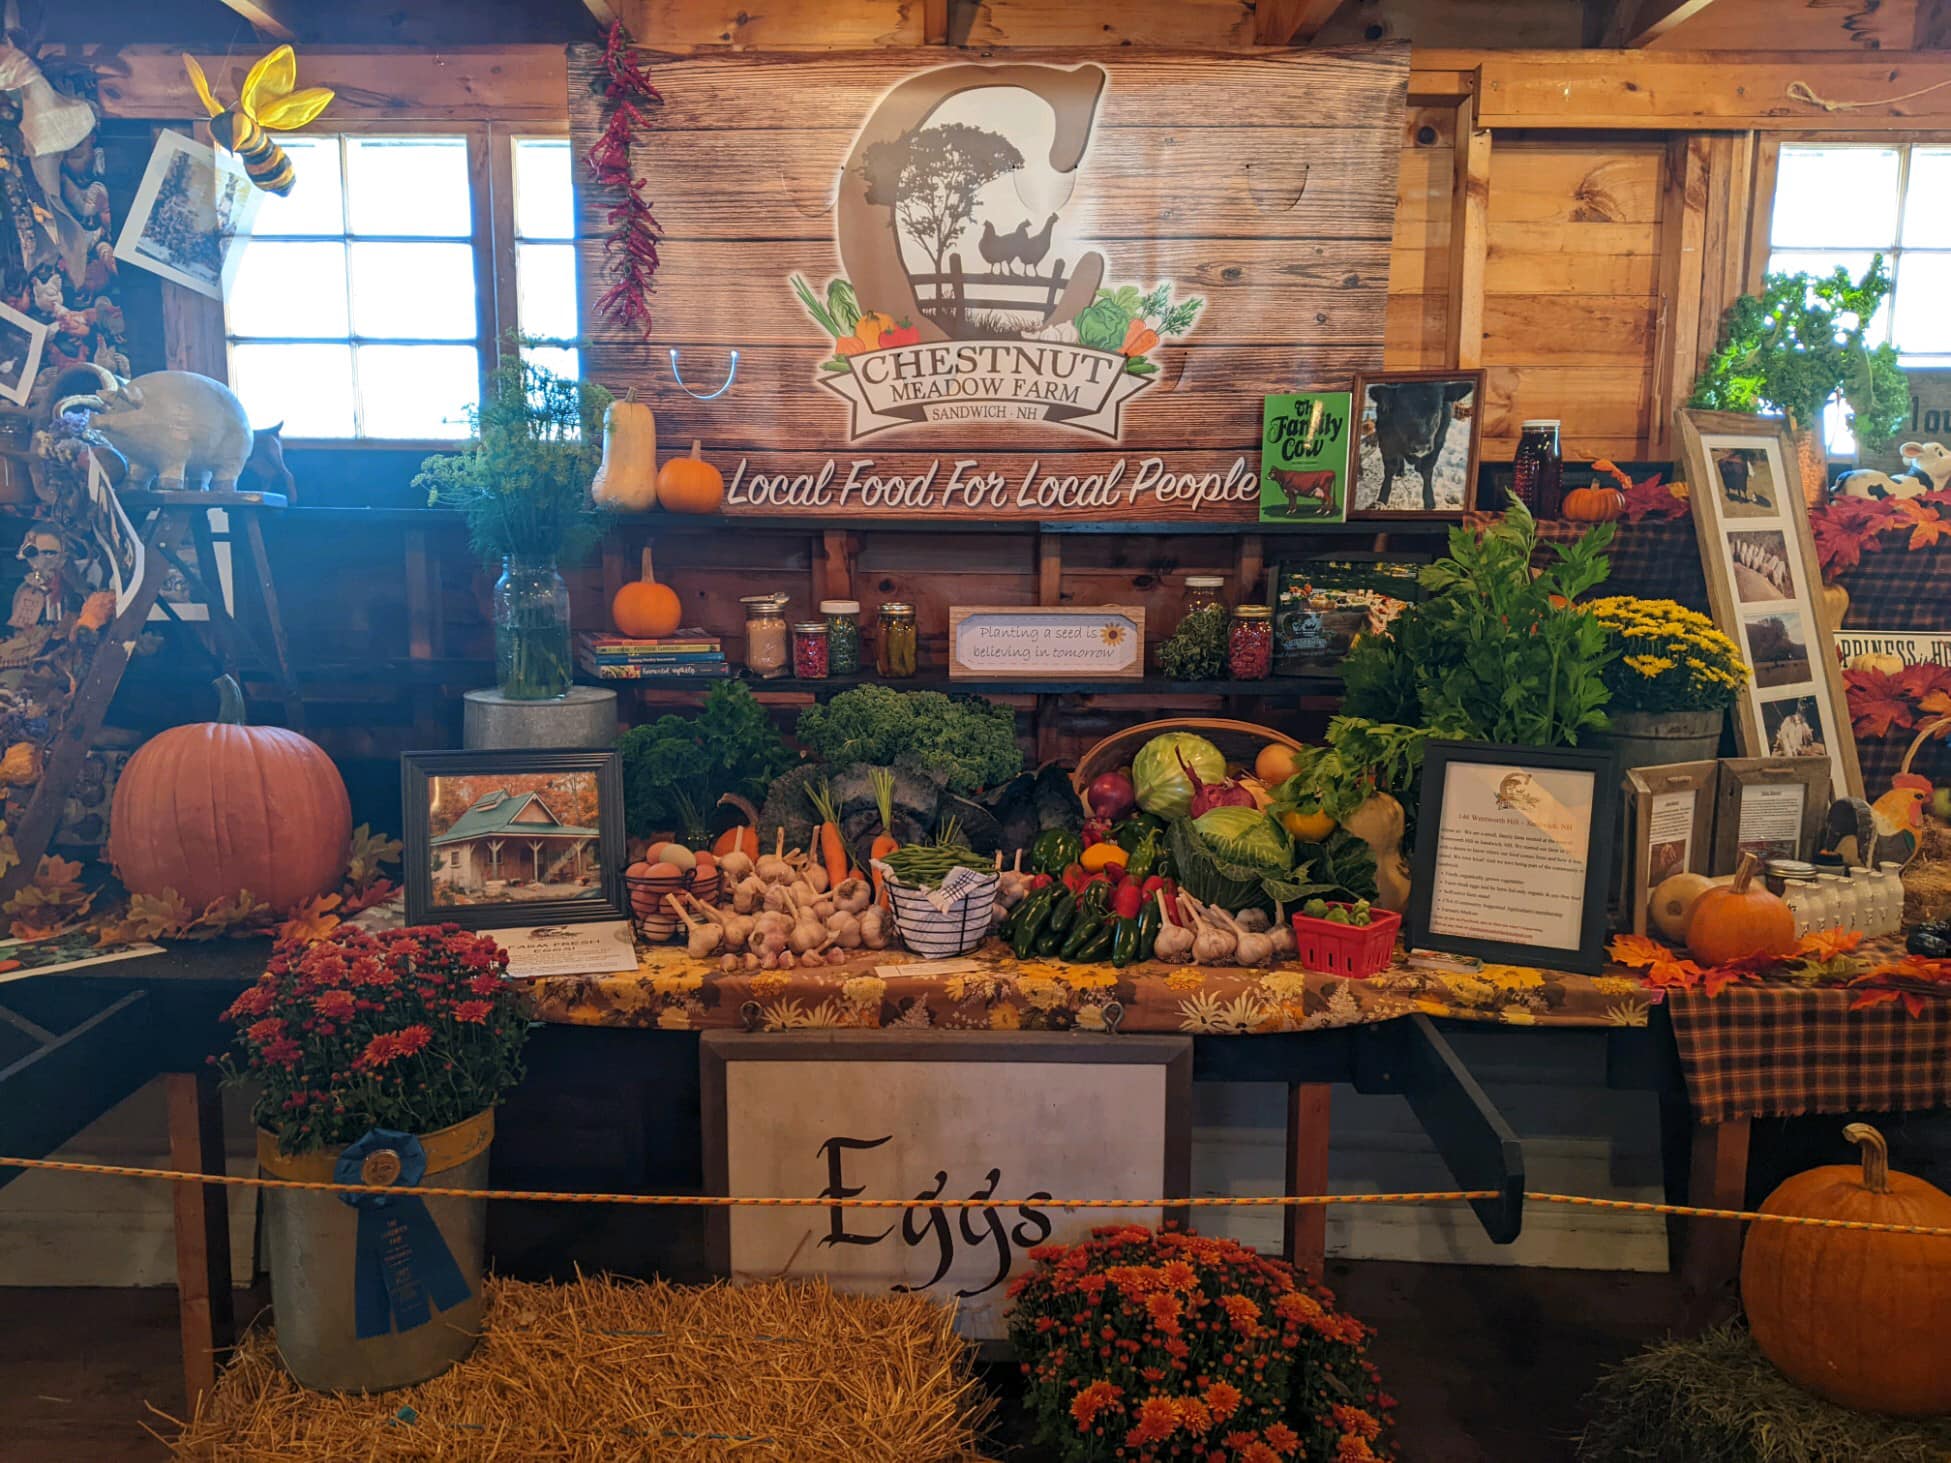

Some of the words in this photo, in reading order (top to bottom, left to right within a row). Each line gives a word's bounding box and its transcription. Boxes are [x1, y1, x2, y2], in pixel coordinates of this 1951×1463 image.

[861, 345, 1114, 385] CHESTNUT
[889, 377, 1003, 402] MEADOW
[1012, 378, 1081, 404] FARM
[932, 405, 1007, 421] SANDWICH
[1016, 407, 1038, 420] NH
[1282, 437, 1324, 461] Cow
[727, 457, 836, 506] Local
[839, 458, 940, 508] Food
[942, 459, 1009, 508] For
[1016, 458, 1126, 508] Local
[1129, 456, 1261, 511] People
[979, 625, 1039, 642] Planting
[1043, 629, 1052, 639] a
[1055, 625, 1082, 639] seed
[1086, 625, 1098, 639] is
[973, 645, 1031, 661] believing
[1034, 646, 1050, 657] in
[1052, 648, 1115, 658] tomorrow
[816, 1134, 1054, 1299] Eggs
